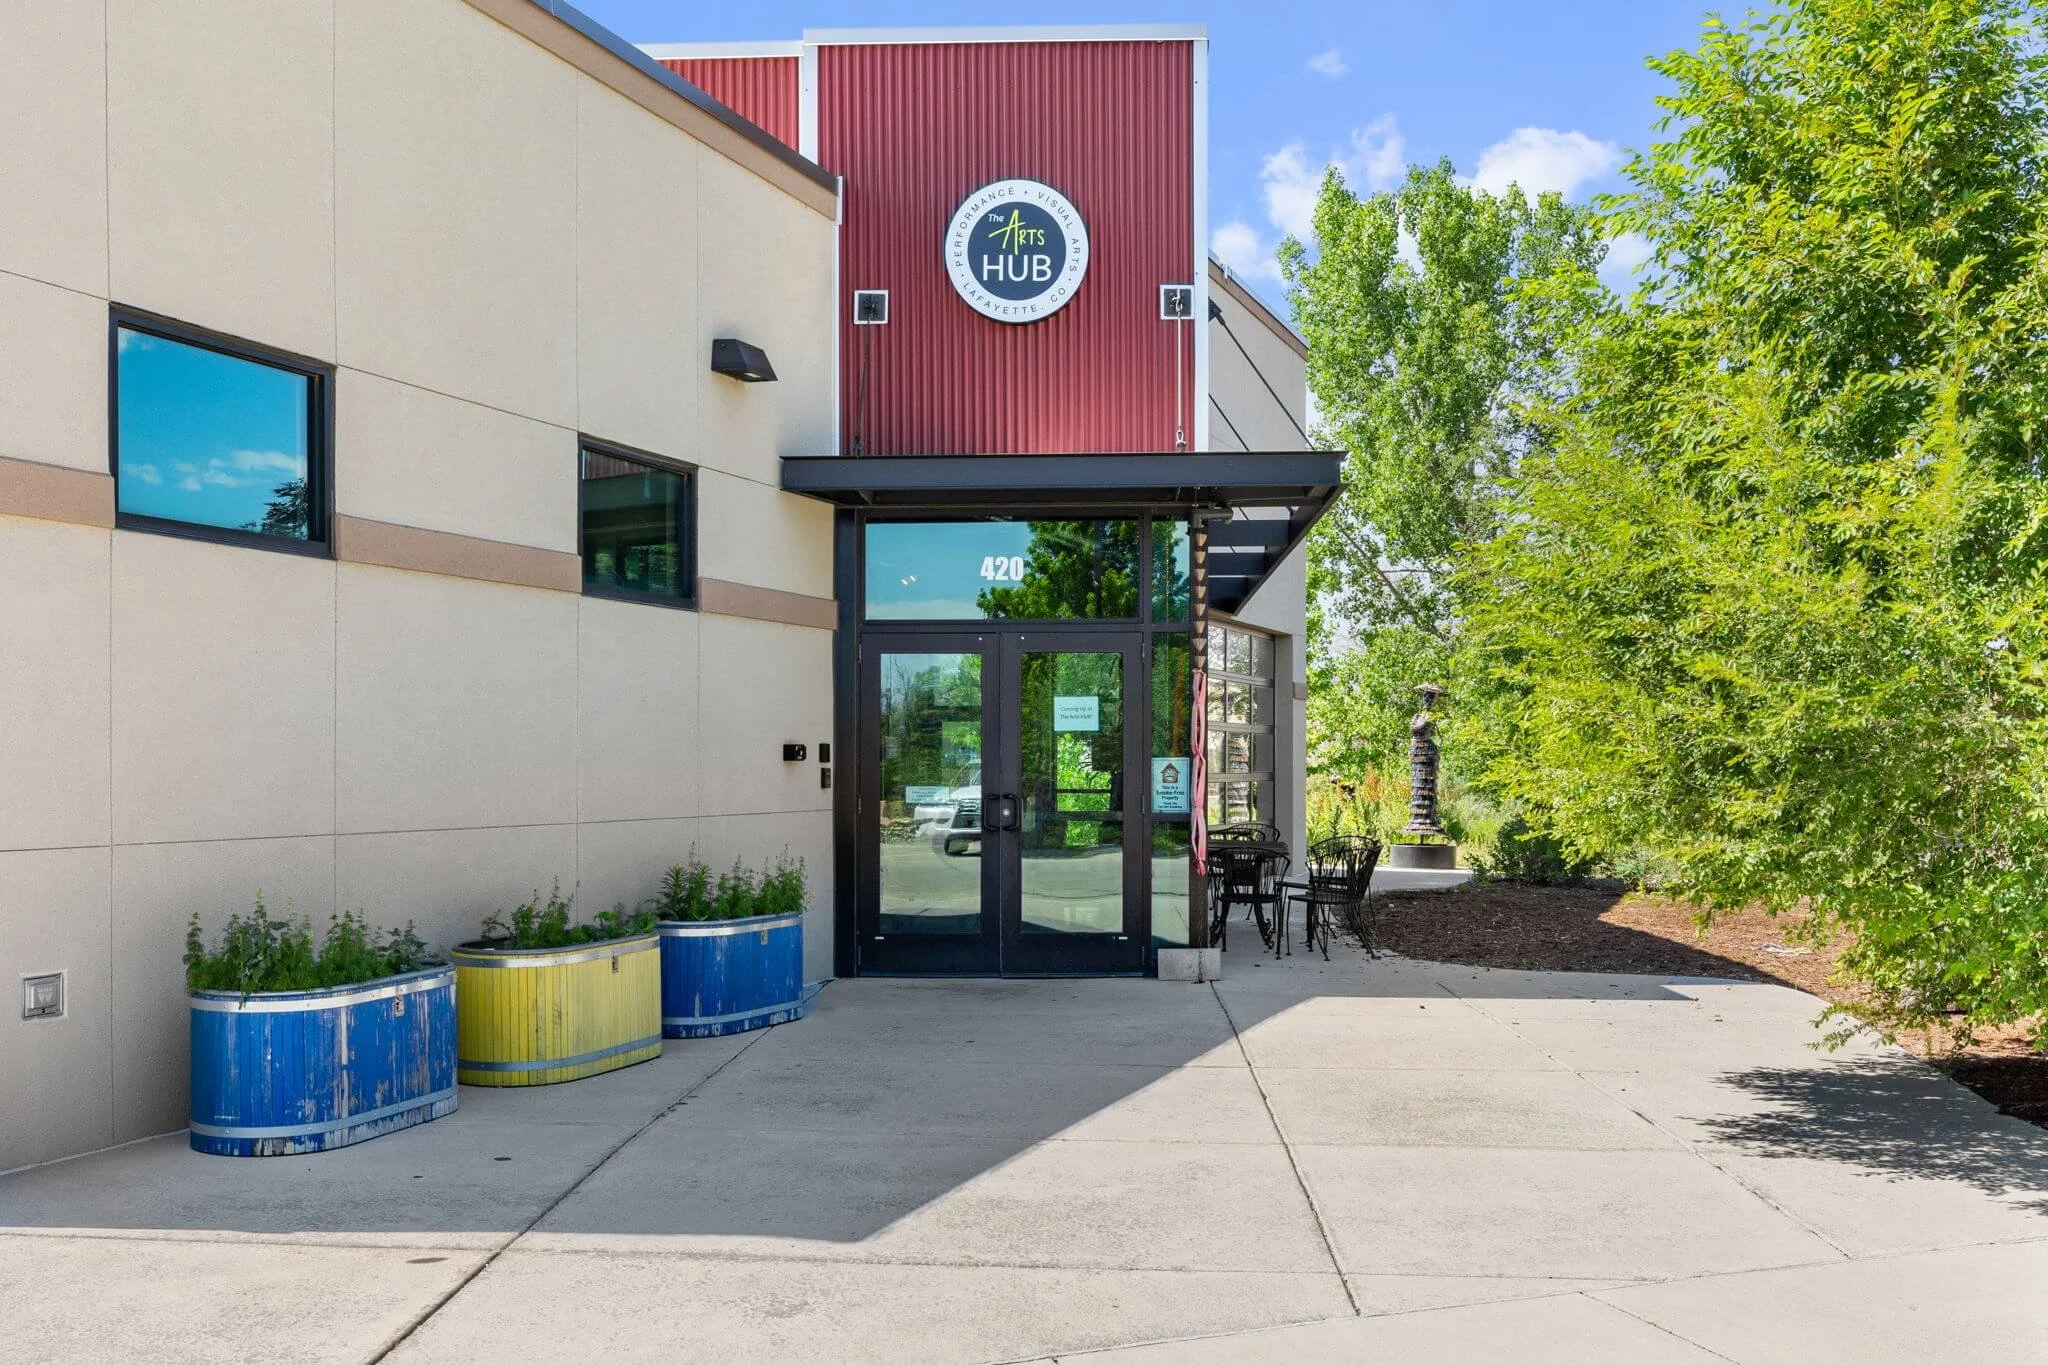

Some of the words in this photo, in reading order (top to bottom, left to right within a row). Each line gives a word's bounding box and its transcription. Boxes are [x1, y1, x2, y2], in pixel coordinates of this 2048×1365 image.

[954, 187, 1015, 267] PERFORMANCE
[1038, 191, 1073, 230] VISUAL
[1069, 238, 1081, 272] ARTS
[988, 213, 1004, 223] The
[982, 254, 1052, 282] HUB
[1050, 287, 1066, 303] CO
[980, 556, 1024, 581] 420
